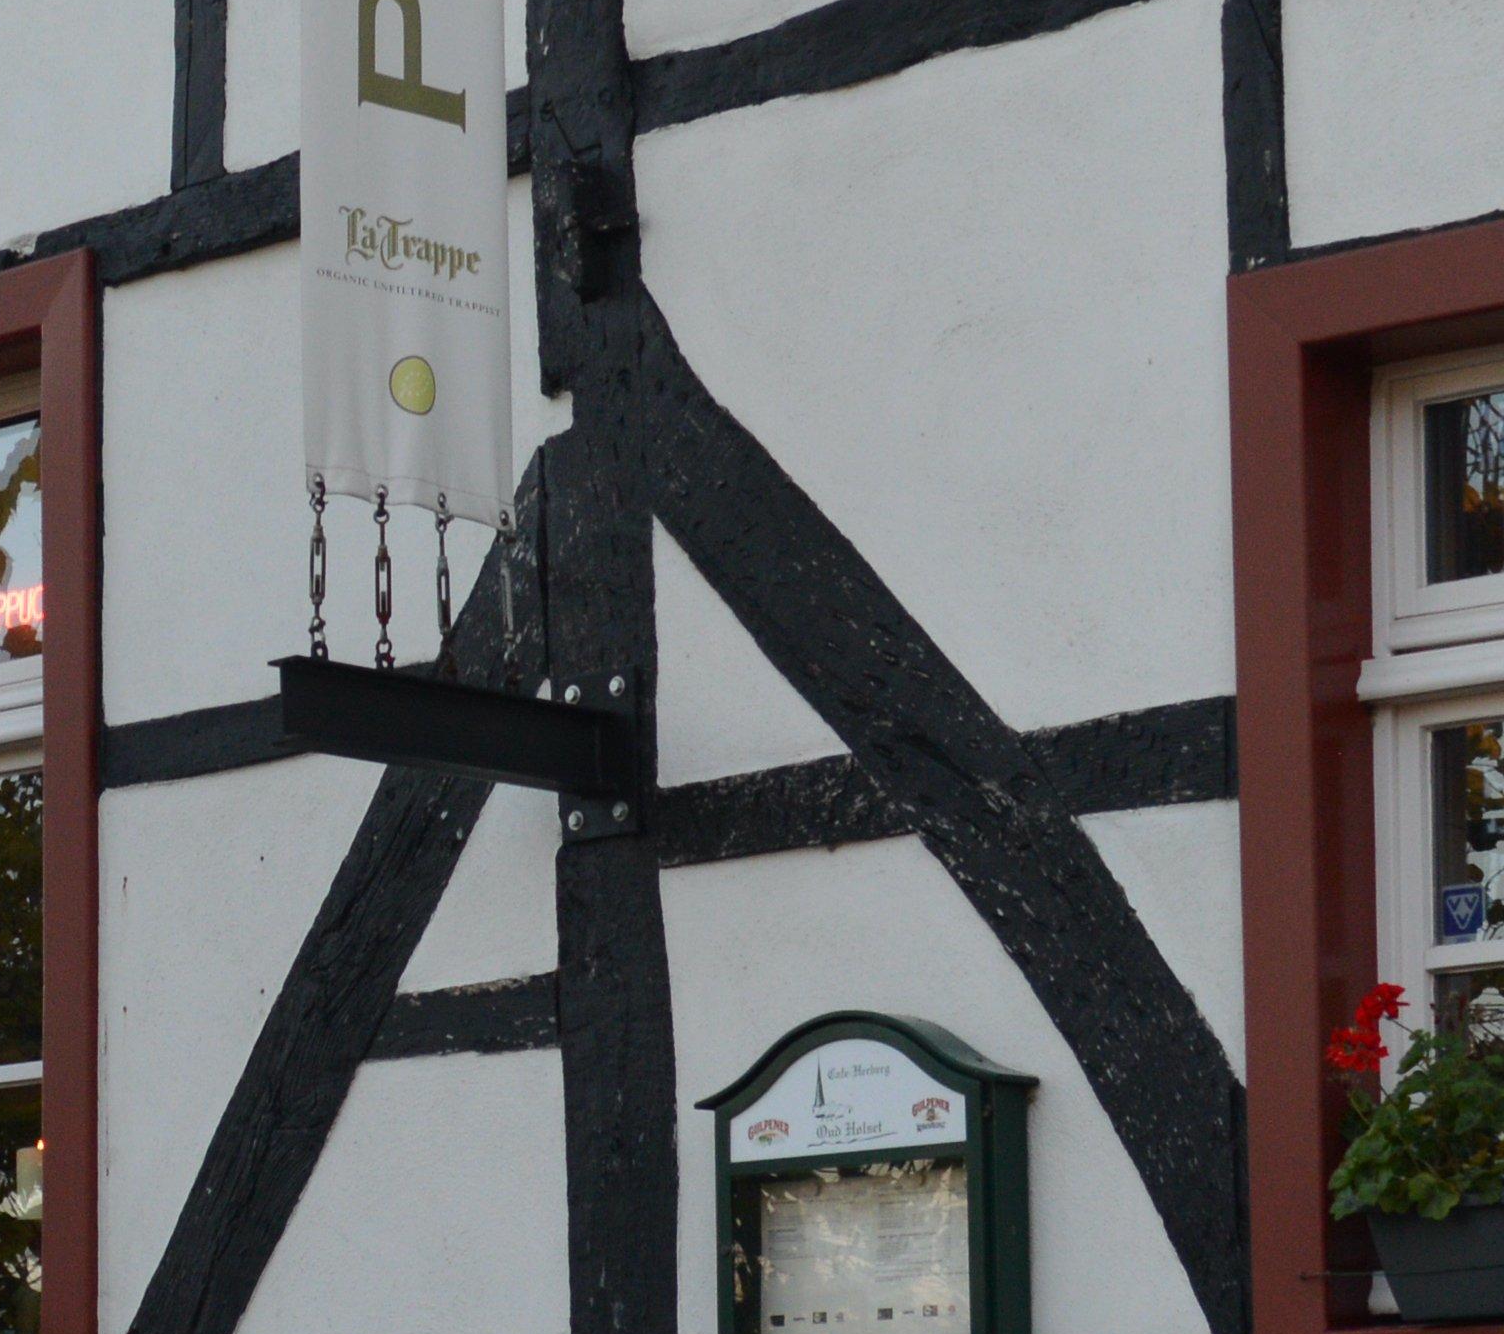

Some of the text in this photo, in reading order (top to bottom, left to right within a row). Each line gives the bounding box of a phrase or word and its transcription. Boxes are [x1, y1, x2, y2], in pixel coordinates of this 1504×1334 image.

[338, 205, 482, 282] La Trappe
[315, 268, 502, 317] ORGANIC UNFILTERED TRAPPIST
[911, 1097, 951, 1117] GULPENER
[747, 1118, 790, 1141] GULPENER
[815, 1120, 883, 1139] Oud Holset
